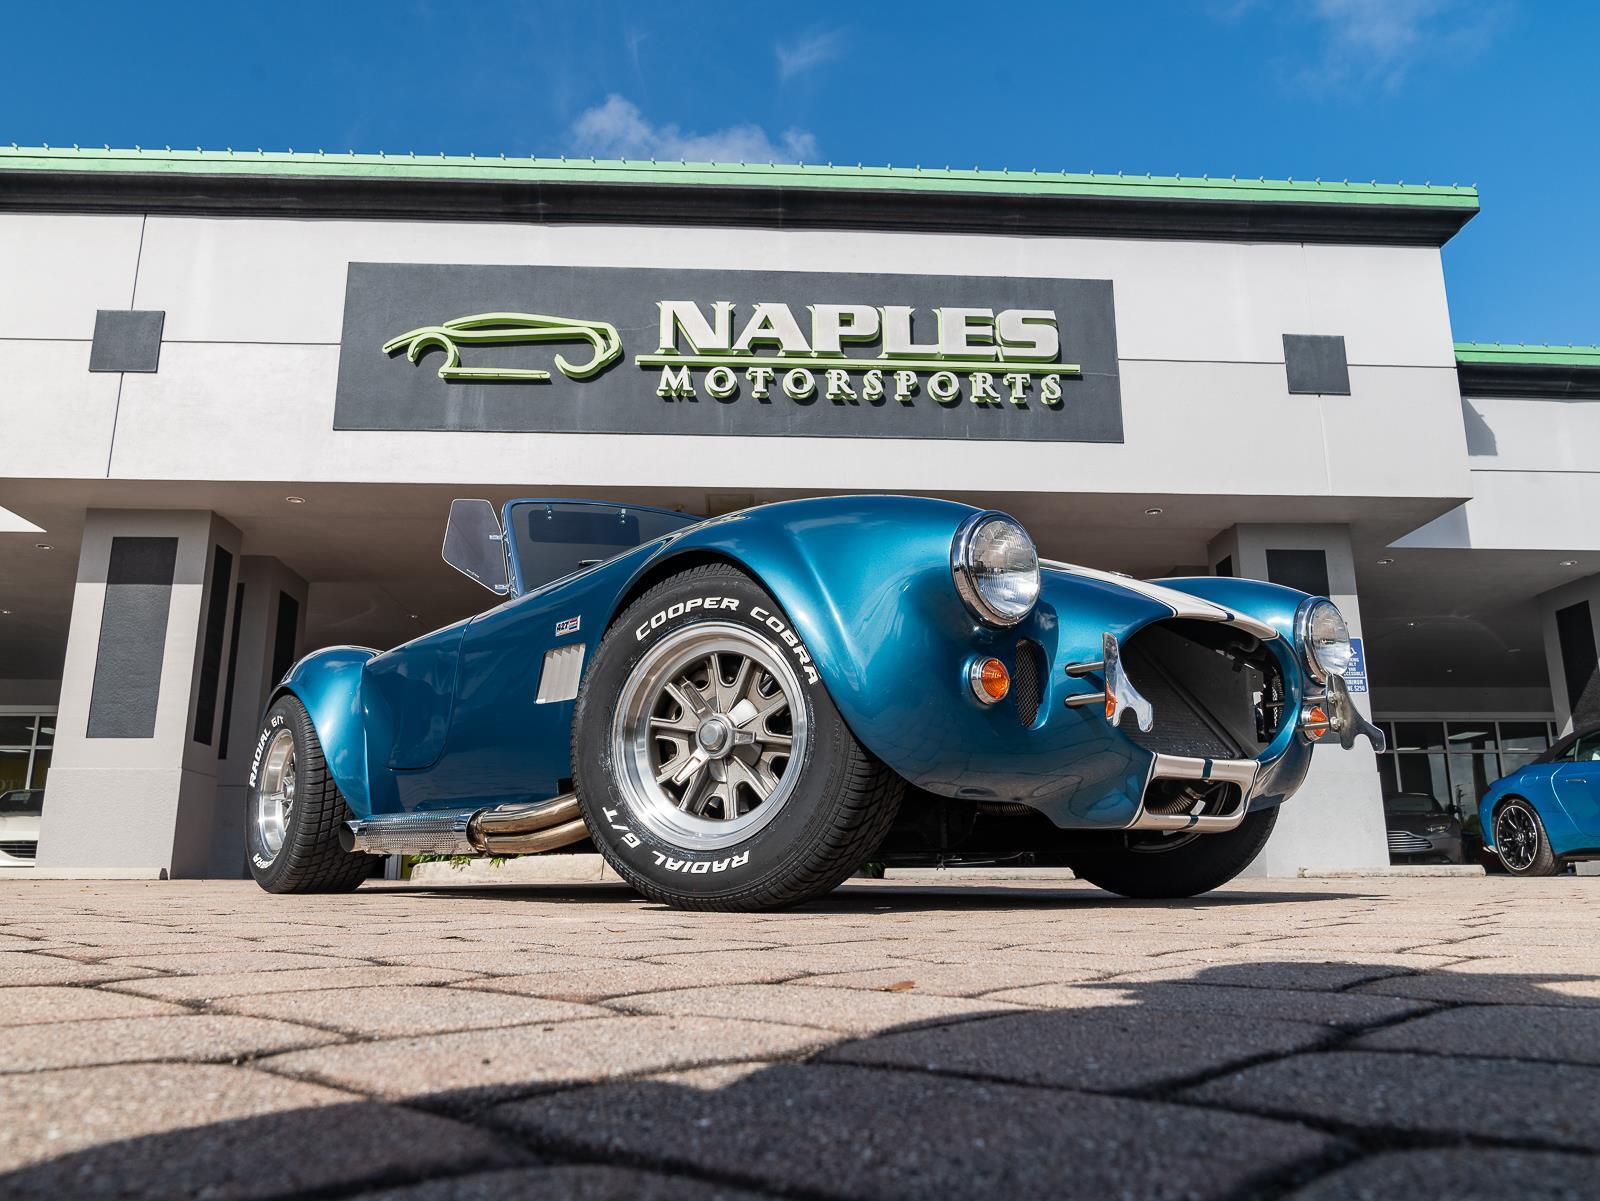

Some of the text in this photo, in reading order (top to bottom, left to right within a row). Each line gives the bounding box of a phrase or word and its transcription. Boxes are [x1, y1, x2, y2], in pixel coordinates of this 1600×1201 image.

[656, 300, 1061, 362] NAPLES
[656, 365, 1063, 406] MOTORSPORTS
[556, 621, 570, 631] 427
[635, 596, 819, 685] COOPER COBRA
[249, 728, 272, 788] RADIAL
[602, 807, 750, 874] RADIAL G/T
